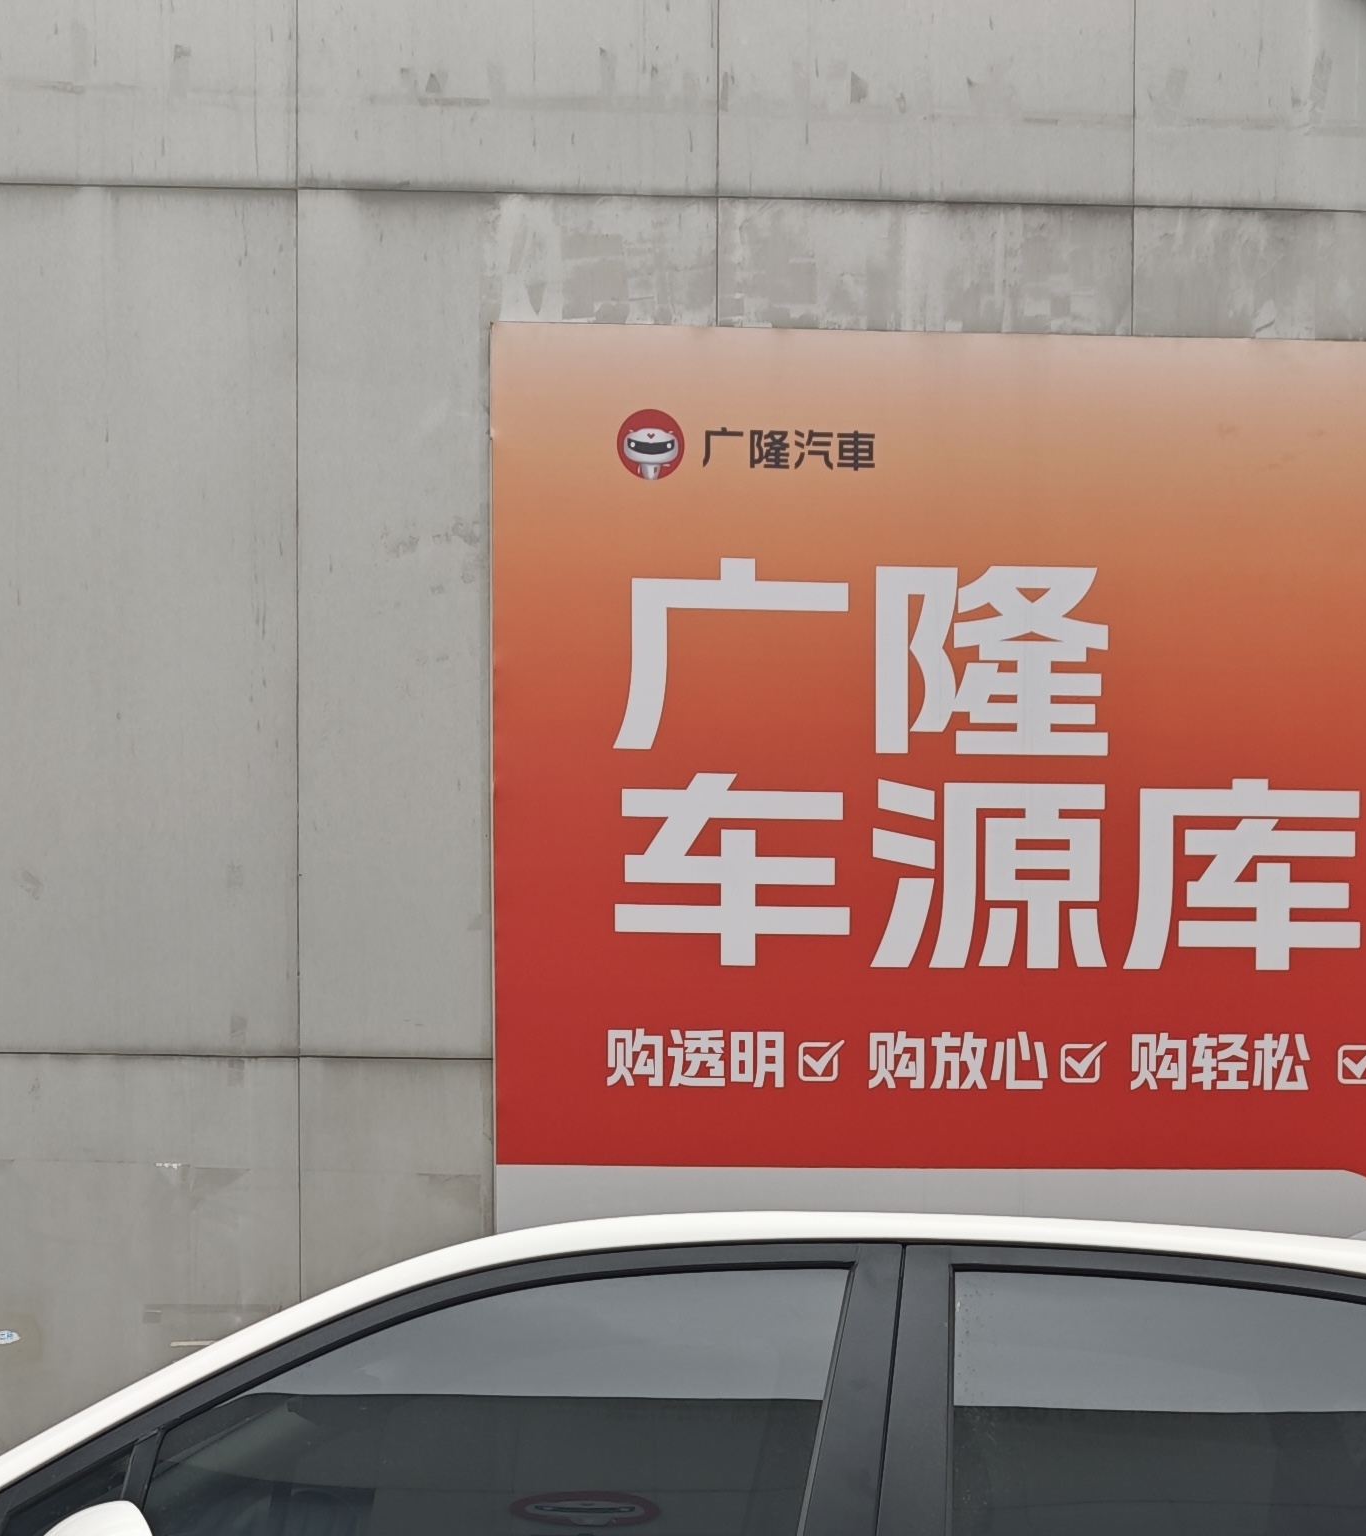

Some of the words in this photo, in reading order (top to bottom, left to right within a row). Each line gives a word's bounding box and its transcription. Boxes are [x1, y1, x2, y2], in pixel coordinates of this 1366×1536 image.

[612, 556, 1111, 757] 广隆
[614, 772, 1362, 971] 车源库
[606, 1029, 786, 1090] 购透明
[867, 1031, 1048, 1091] 购放心
[1129, 1033, 1310, 1092] 购轻松
